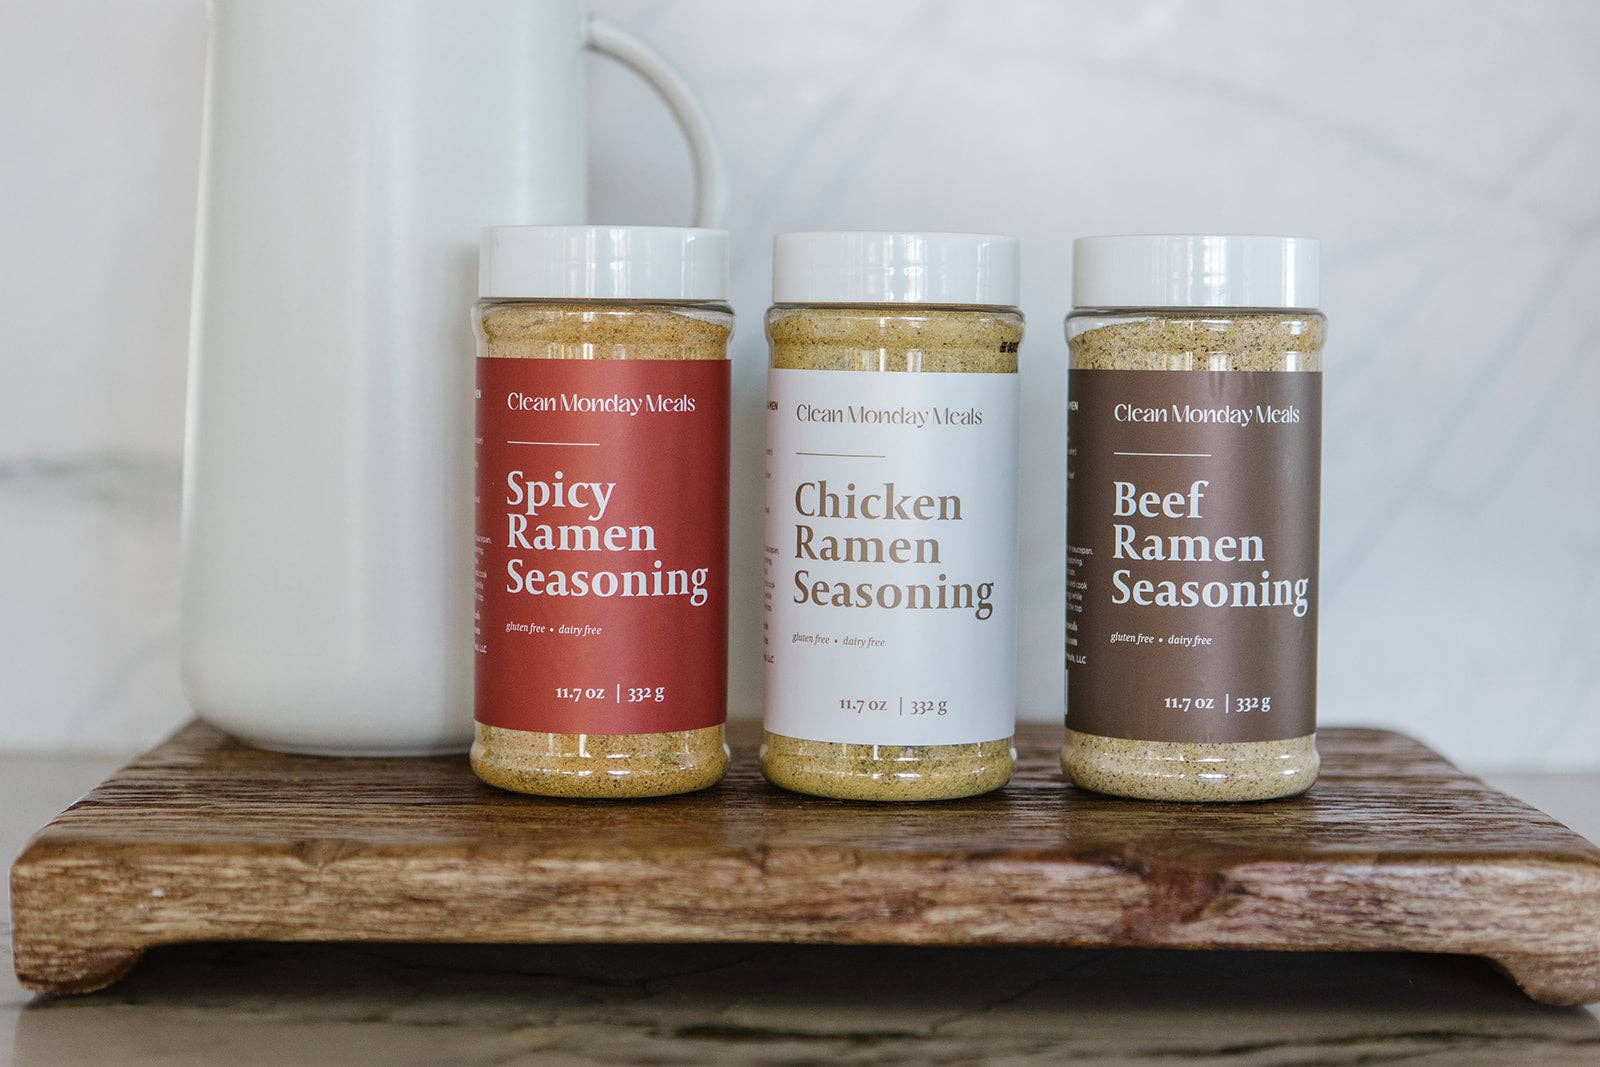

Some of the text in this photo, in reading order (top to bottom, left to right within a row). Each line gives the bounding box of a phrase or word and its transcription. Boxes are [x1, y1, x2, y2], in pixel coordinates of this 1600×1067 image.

[507, 392, 696, 416] Clean Monday Meals
[796, 403, 843, 423] Clean
[848, 405, 929, 428] Monday
[933, 407, 983, 426] Meals
[1114, 403, 1300, 427] Clean Monday Meals
[506, 470, 616, 522] Spicy
[795, 480, 963, 520] Chicken
[1112, 480, 1210, 519] Beef
[506, 513, 657, 551] Ramen
[794, 524, 941, 564] Ramen
[1112, 524, 1265, 562] Ramen
[506, 558, 709, 607] Seasoning
[793, 569, 994, 620] Seasoning
[1111, 569, 1309, 618] Seasoning
[505, 622, 602, 636] gluten free dairy free
[791, 632, 887, 648] gluten free dairy free
[1110, 632, 1213, 647] gluten free dairy free
[555, 686, 665, 703] 11.7 oz 332 g
[839, 699, 948, 715] 11.7 oz 332 g
[1164, 696, 1272, 713] 11.7 oz 332 g
